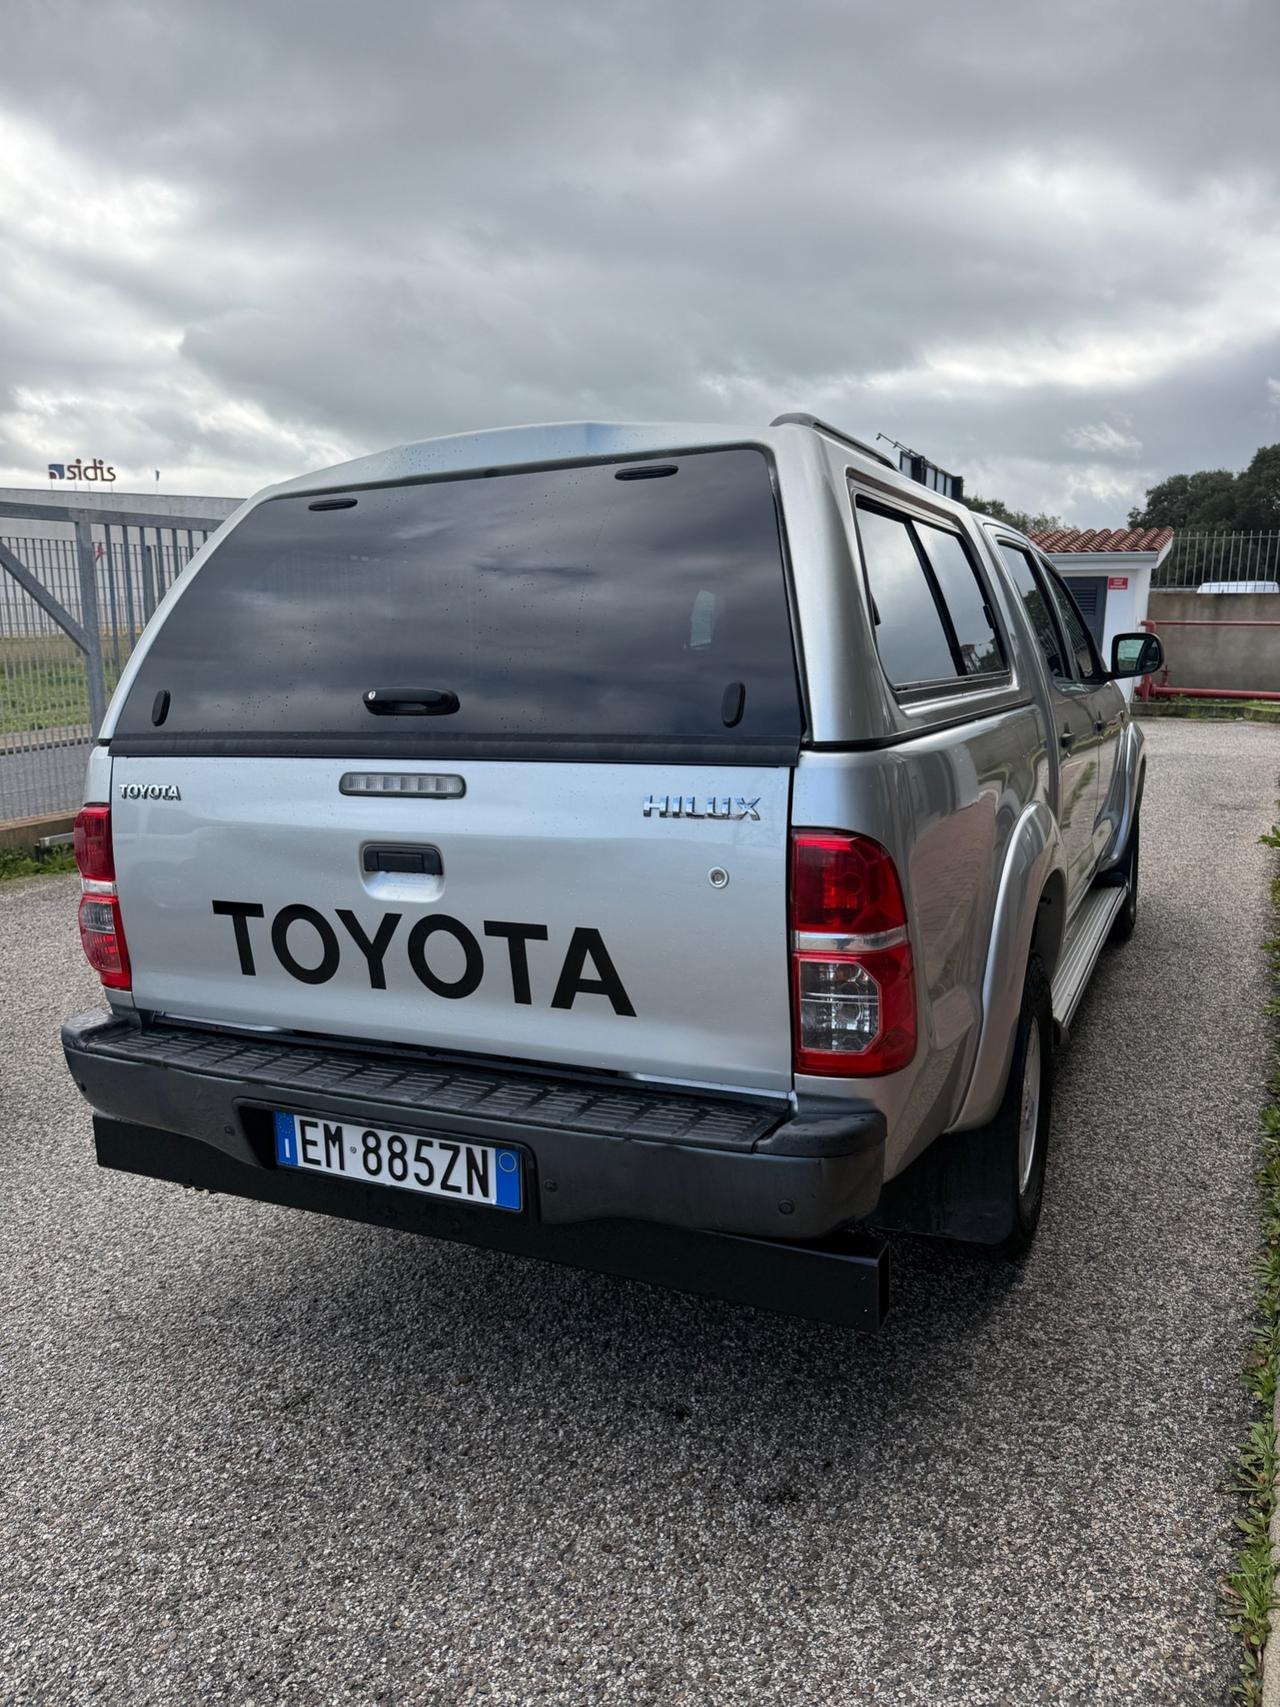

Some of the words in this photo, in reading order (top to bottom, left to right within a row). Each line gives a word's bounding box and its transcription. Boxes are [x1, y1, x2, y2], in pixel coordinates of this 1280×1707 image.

[66, 458, 116, 481] sidis
[119, 784, 181, 801] TOYOTA
[643, 795, 760, 820] HILUX
[212, 900, 637, 1017] TOYOTA
[299, 1119, 345, 1171] EM
[361, 1130, 490, 1198] 885ZN
